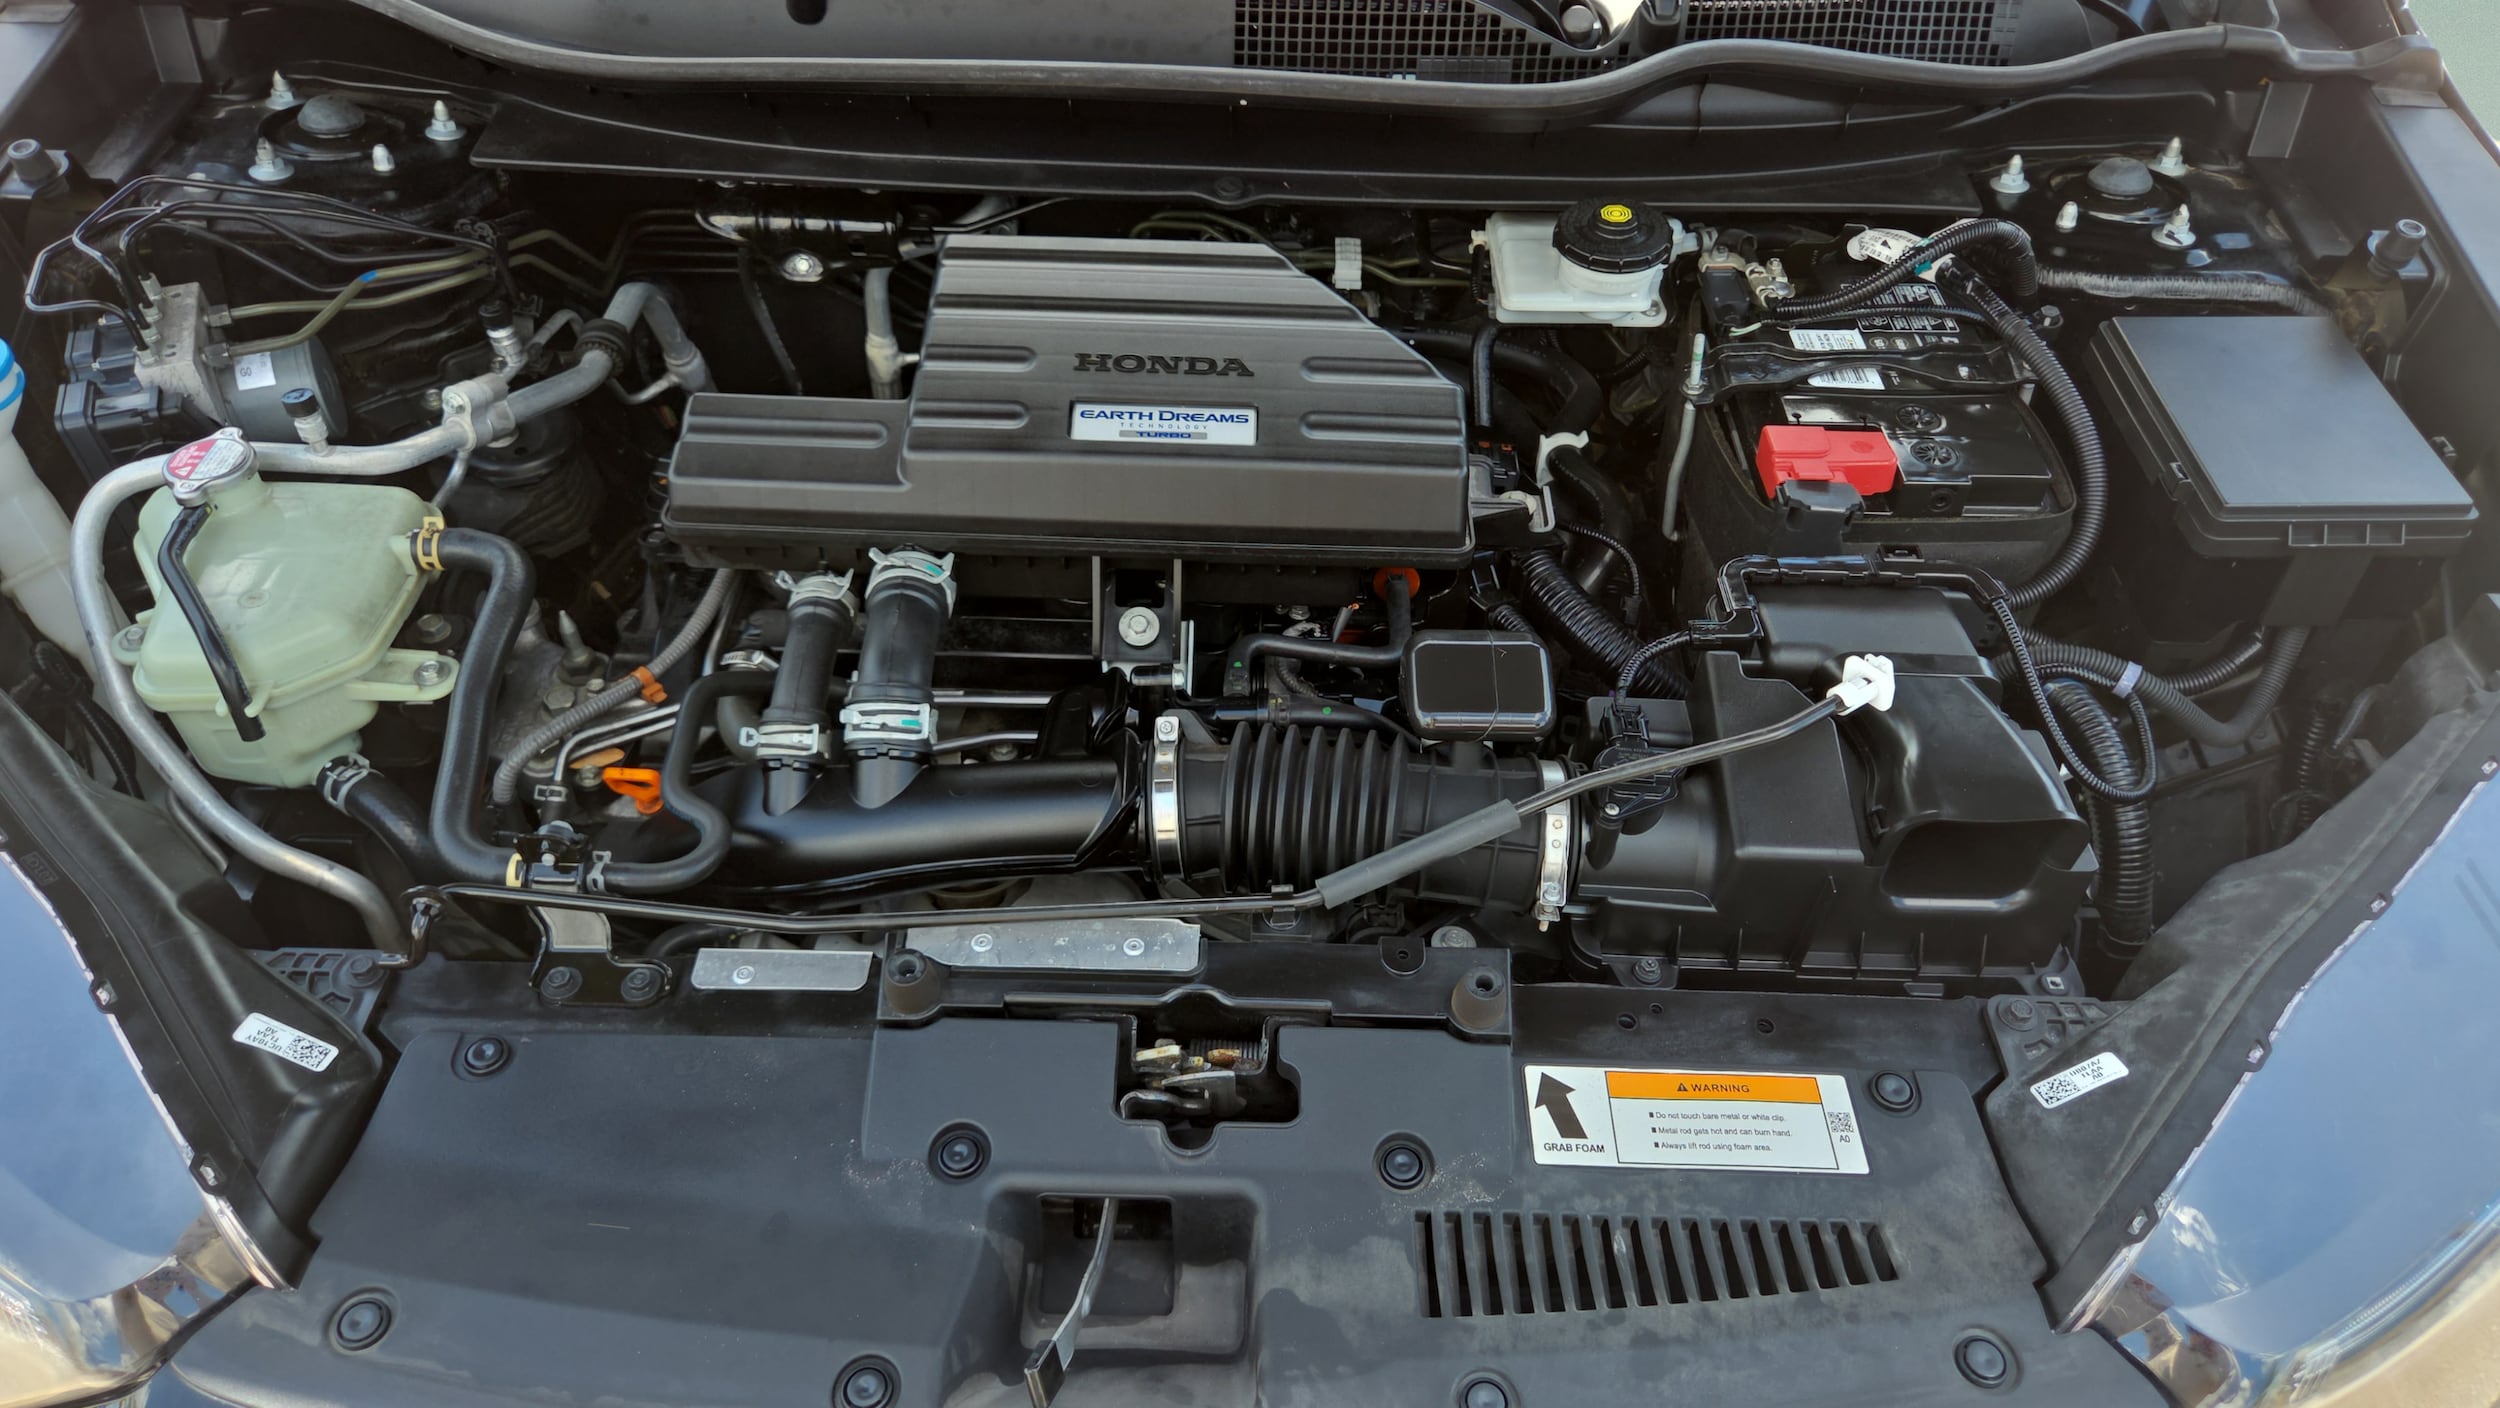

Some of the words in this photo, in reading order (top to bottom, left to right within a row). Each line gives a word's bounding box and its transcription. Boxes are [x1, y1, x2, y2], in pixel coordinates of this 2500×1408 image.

[1073, 352, 1255, 377] HONDA
[1079, 409, 1153, 421] EARTH
[1158, 410, 1249, 424] DREAMS
[1120, 422, 1208, 430] TECHNOLOGY
[1136, 430, 1192, 439] TURBO
[1691, 1083, 1750, 1093] WARNING
[1655, 1111, 1667, 1119] Do
[1668, 1112, 1679, 1120] not
[1681, 1112, 1701, 1120] touch
[1702, 1112, 1719, 1120] bare
[1751, 1113, 1770, 1121] white
[1680, 1127, 1692, 1135] rod
[1693, 1128, 1709, 1136] gets
[1754, 1128, 1771, 1136] burn
[1772, 1129, 1793, 1137] hand.
[1543, 1142, 1573, 1152] GRAB
[1575, 1143, 1606, 1153] FOAM
[1661, 1142, 1687, 1150] Always
[1688, 1142, 1697, 1150] lift
[1713, 1143, 1733, 1151] using
[1734, 1143, 1752, 1151] foam
